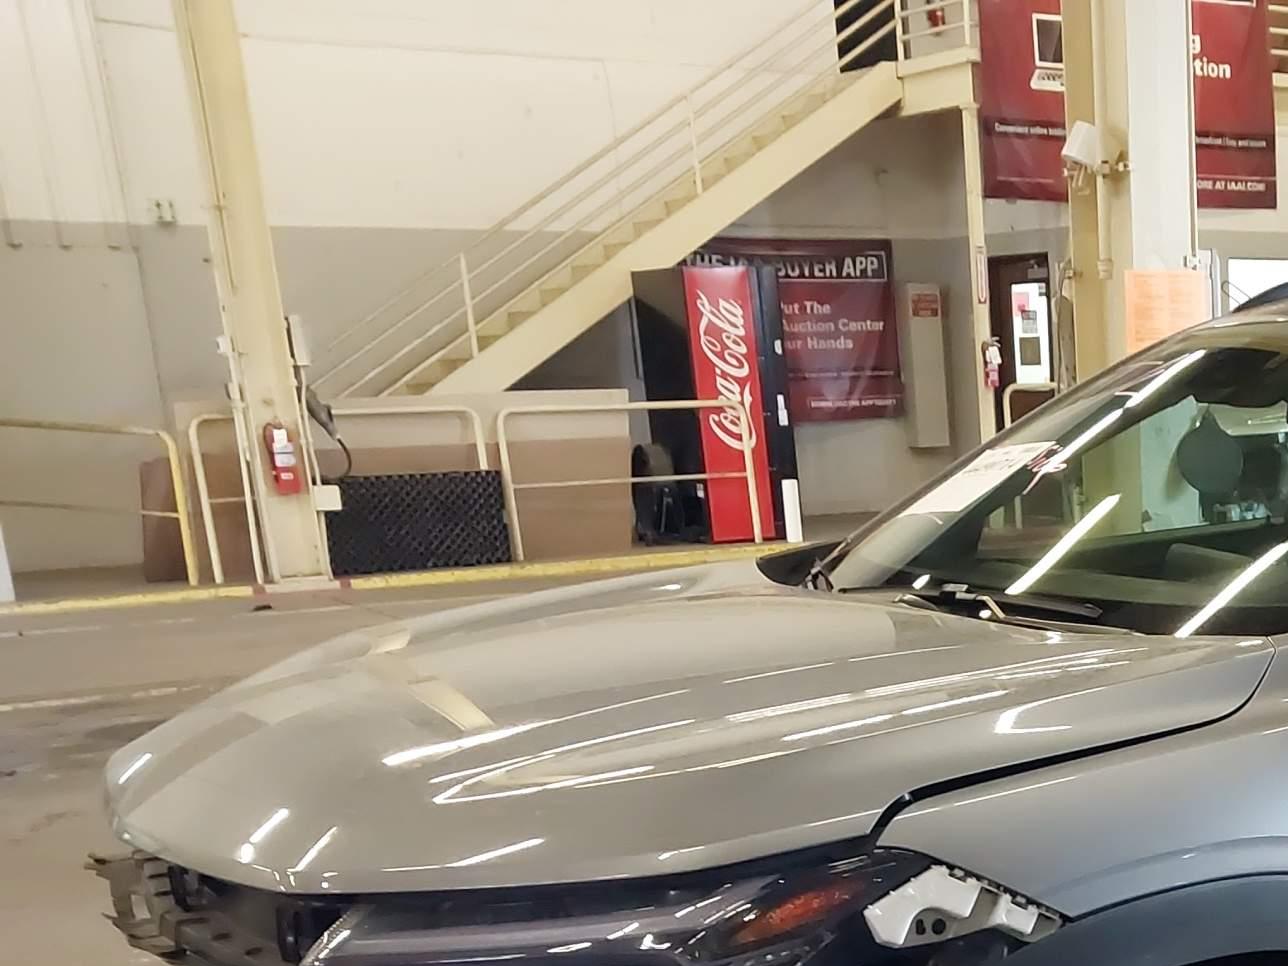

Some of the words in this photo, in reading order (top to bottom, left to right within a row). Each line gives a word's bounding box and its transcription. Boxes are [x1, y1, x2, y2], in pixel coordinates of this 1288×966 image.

[1193, 55, 1231, 79] tion
[1197, 179, 1213, 190] ORE
[842, 255, 879, 277] APP
[780, 299, 800, 315] ut
[803, 299, 832, 315] The
[838, 317, 885, 332] Center
[806, 334, 854, 351] Hands
